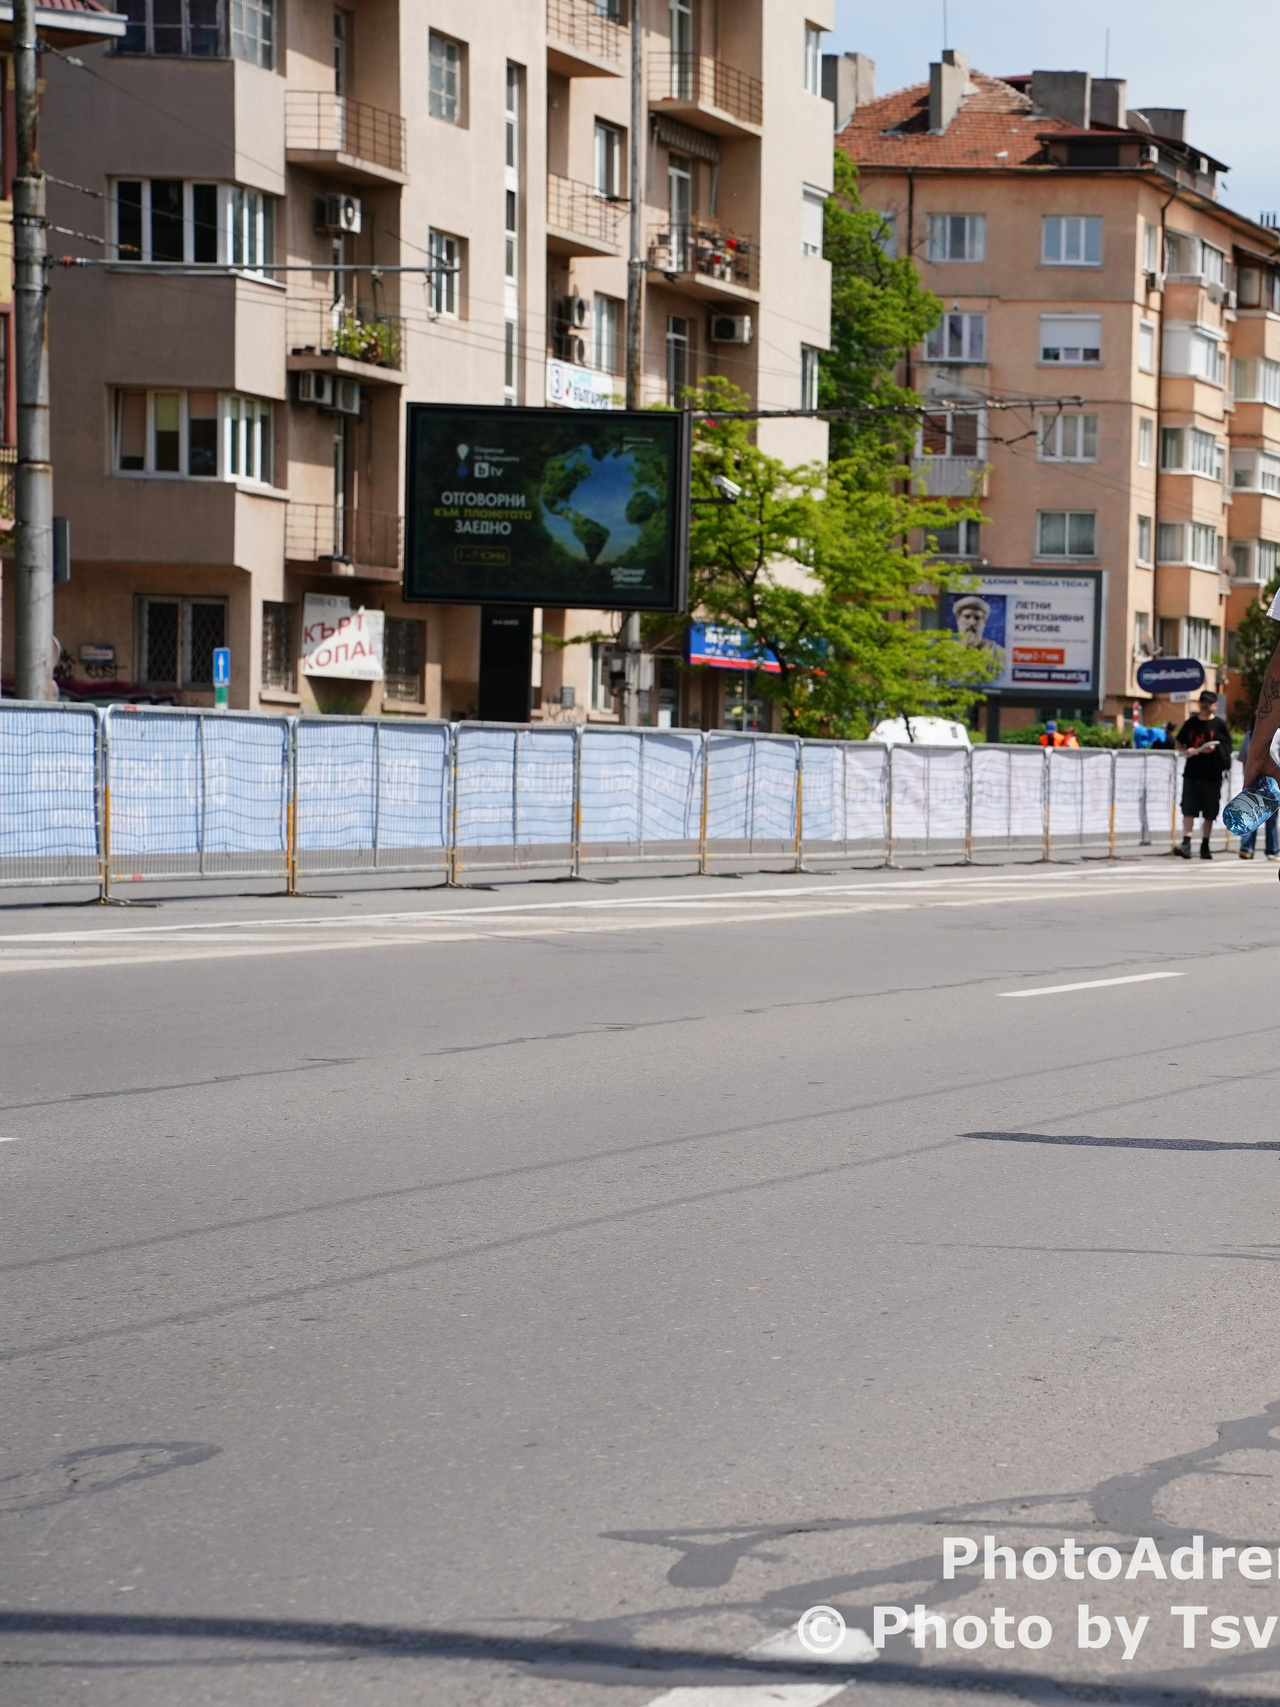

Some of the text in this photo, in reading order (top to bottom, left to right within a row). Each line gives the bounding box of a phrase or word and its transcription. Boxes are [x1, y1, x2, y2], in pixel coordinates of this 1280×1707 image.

[441, 491, 526, 507] ОТГОВОРНИ
[455, 519, 511, 535] ЗАЕДНО
[1015, 601, 1051, 610] ЛЕТНИ
[1015, 613, 1084, 622] ИНТЕНЗИВНИ
[1014, 624, 1061, 633] КУРСОВЕ
